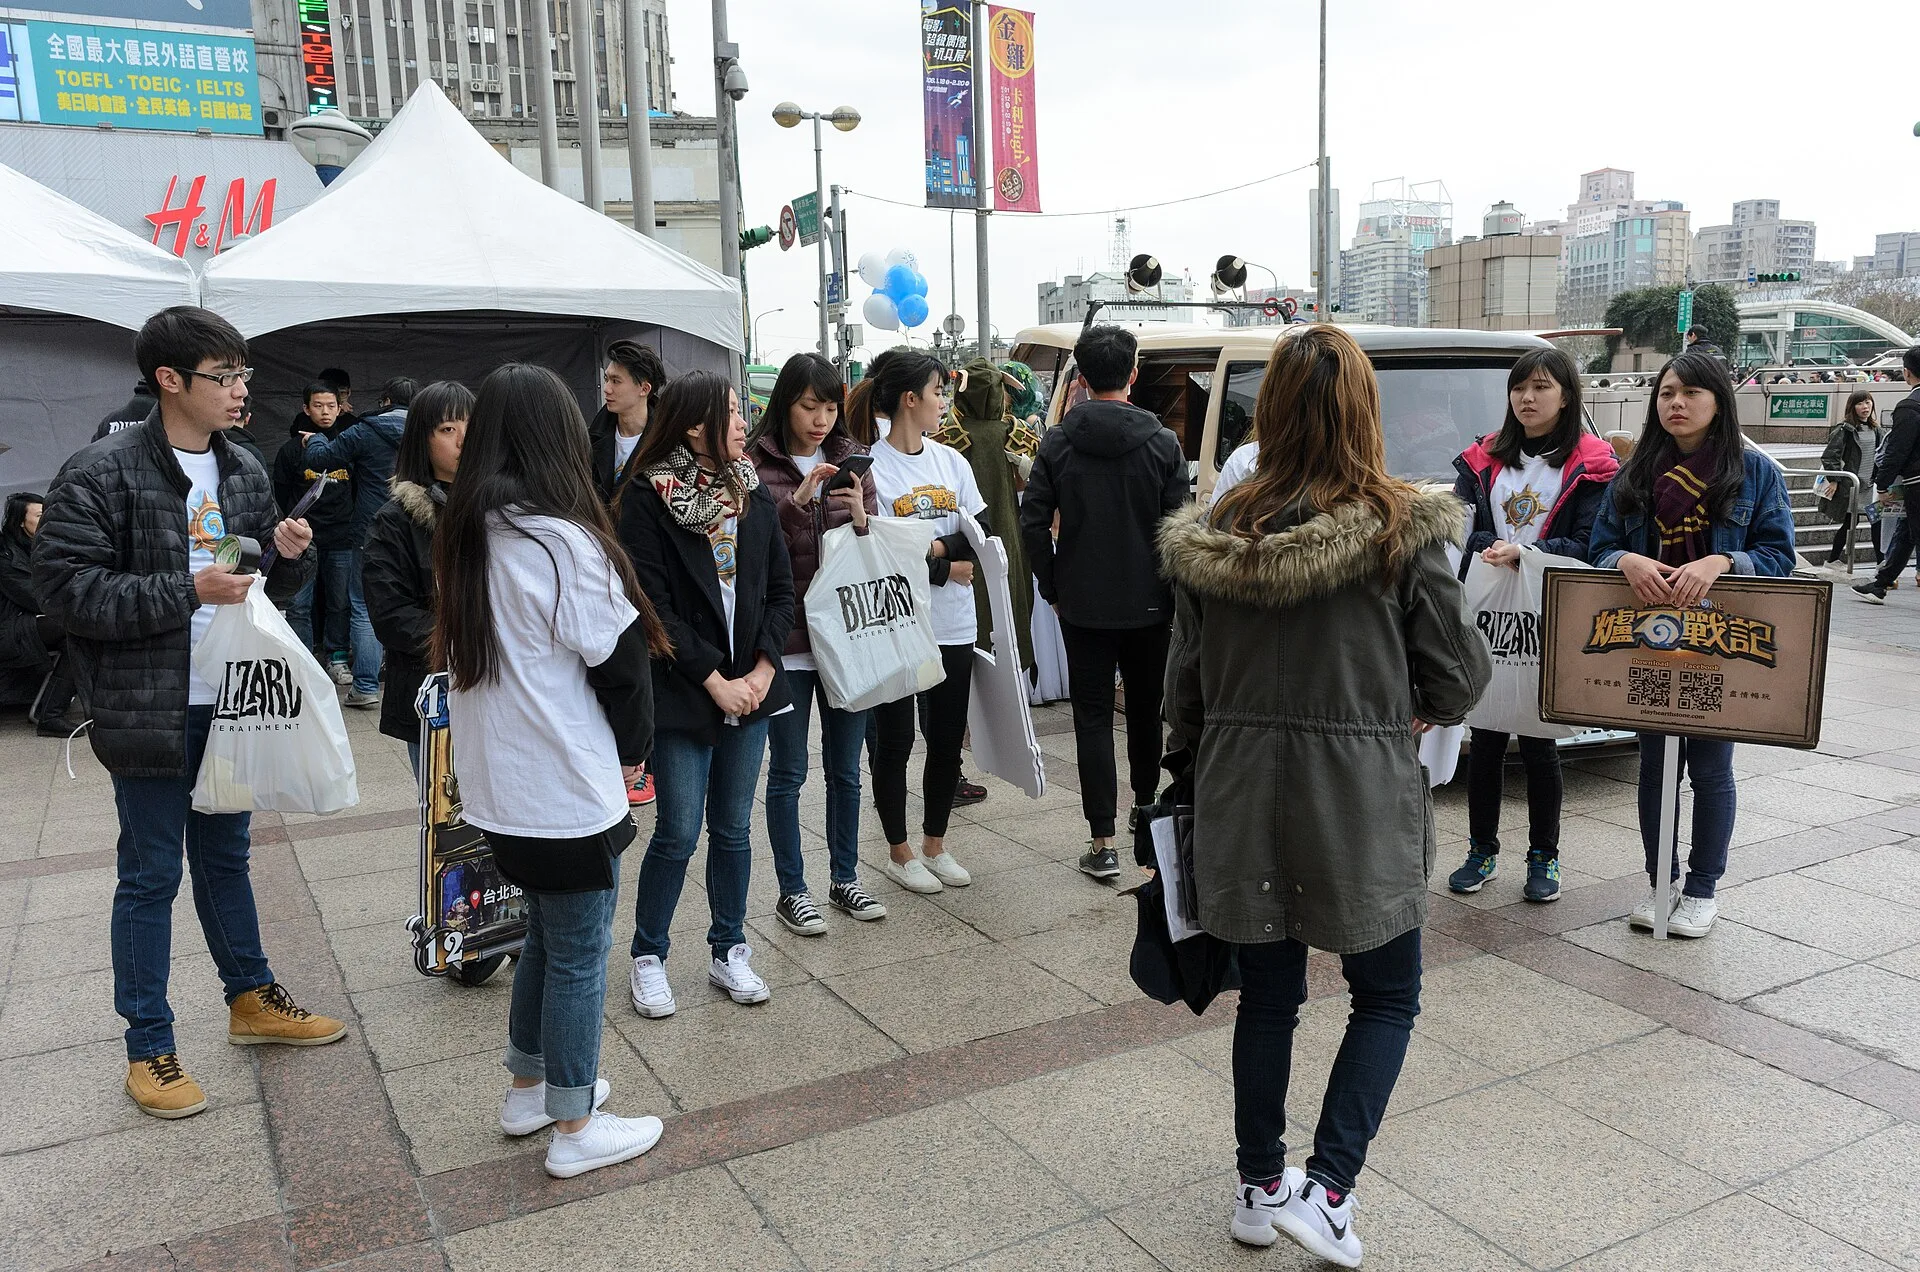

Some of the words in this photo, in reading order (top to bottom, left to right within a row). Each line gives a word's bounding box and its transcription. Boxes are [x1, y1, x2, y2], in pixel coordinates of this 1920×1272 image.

[923, 18, 943, 32] 電影
[47, 33, 249, 73] 全國最大優良外語直營校
[301, 32, 336, 85] TOEIC
[55, 70, 113, 89] TOEFL
[127, 75, 182, 93] TOEIC
[196, 79, 245, 97] IELTS
[144, 175, 278, 259] H&M
[1632, 658, 1670, 668] Download
[1683, 662, 1720, 672] Facebook
[1584, 677, 1622, 688] 下載遊戲
[425, 684, 440, 719] 1
[1640, 708, 1706, 721] playhearthstone.com
